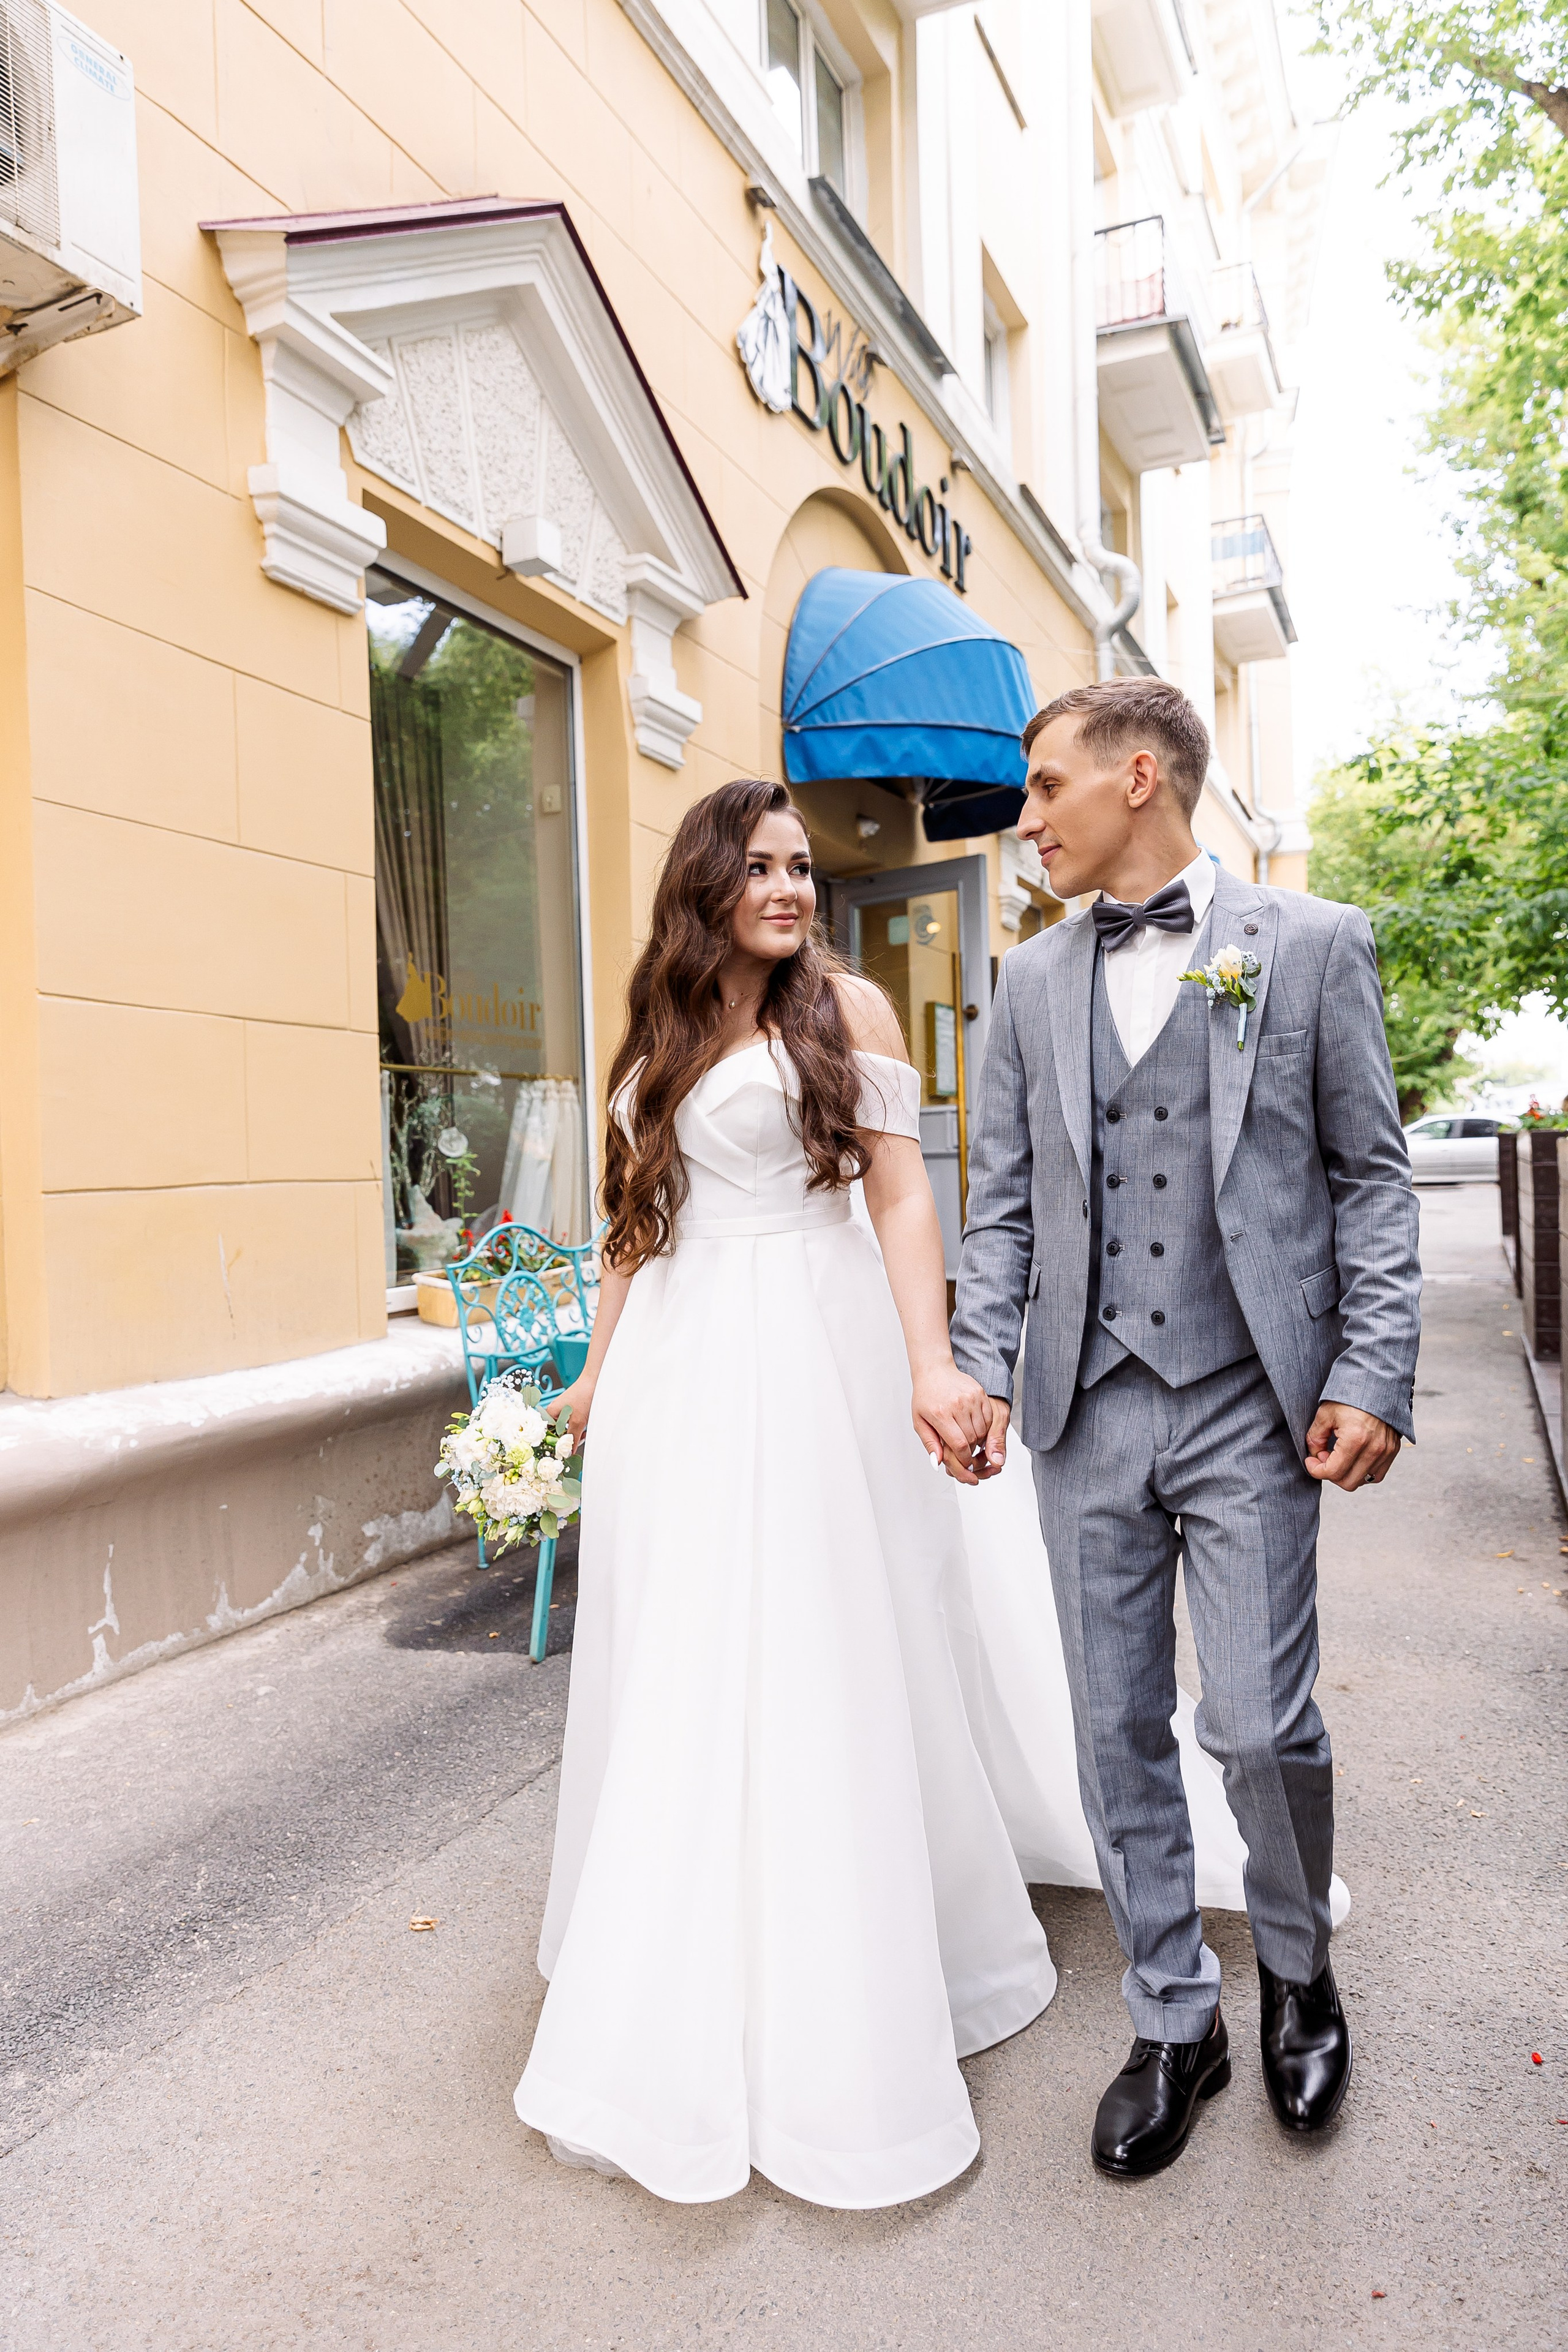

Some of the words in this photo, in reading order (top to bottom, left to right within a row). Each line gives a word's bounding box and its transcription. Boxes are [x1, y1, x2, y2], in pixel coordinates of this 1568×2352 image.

[71, 43, 117, 86] GENERAL
[74, 56, 115, 93] CLIMATE
[776, 263, 973, 593] Boudoir
[420, 971, 541, 1031] Boudoir
